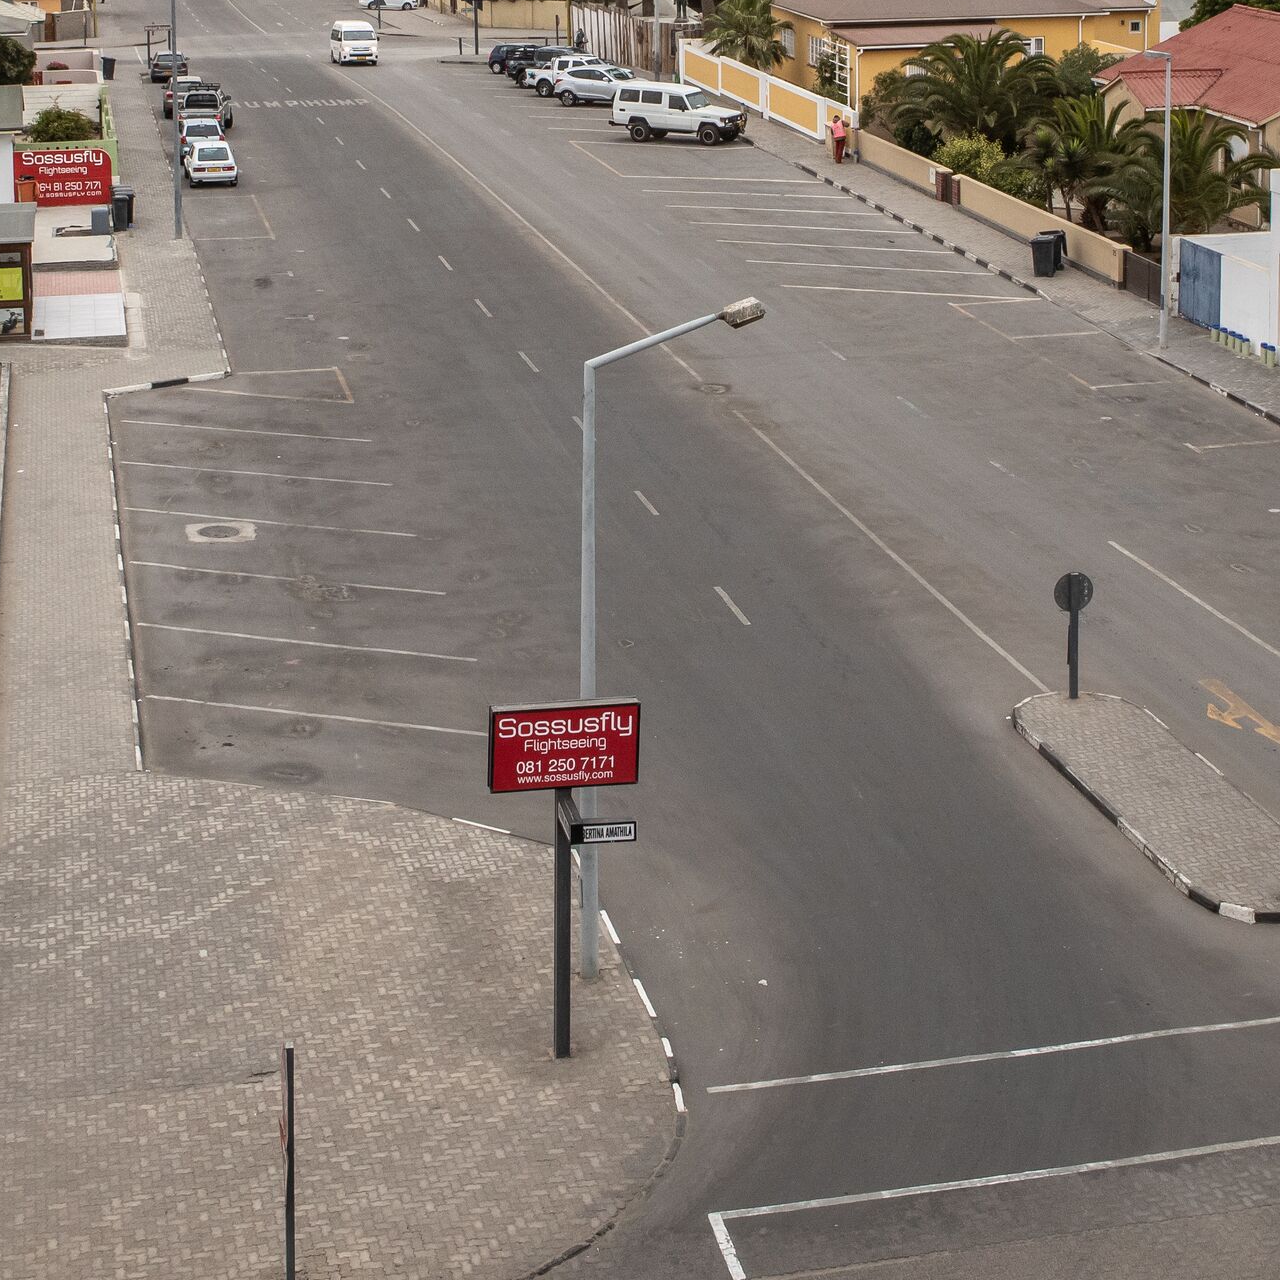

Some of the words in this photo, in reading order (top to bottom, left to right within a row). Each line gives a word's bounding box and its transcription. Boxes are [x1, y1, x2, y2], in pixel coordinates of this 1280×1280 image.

[22, 151, 103, 166] Sossusfly
[39, 166, 87, 176] Flightseeing
[53, 182, 62, 192] 81
[65, 181, 82, 191] 250
[84, 181, 101, 190] 7171
[498, 712, 633, 739] Sossusfly
[524, 736, 607, 754] Flightseeing
[516, 761, 542, 774] 081
[548, 758, 576, 772] 250
[580, 755, 615, 769] 7171
[517, 770, 613, 784] www.sossusfly.com
[606, 826, 632, 838] AMATHILA
